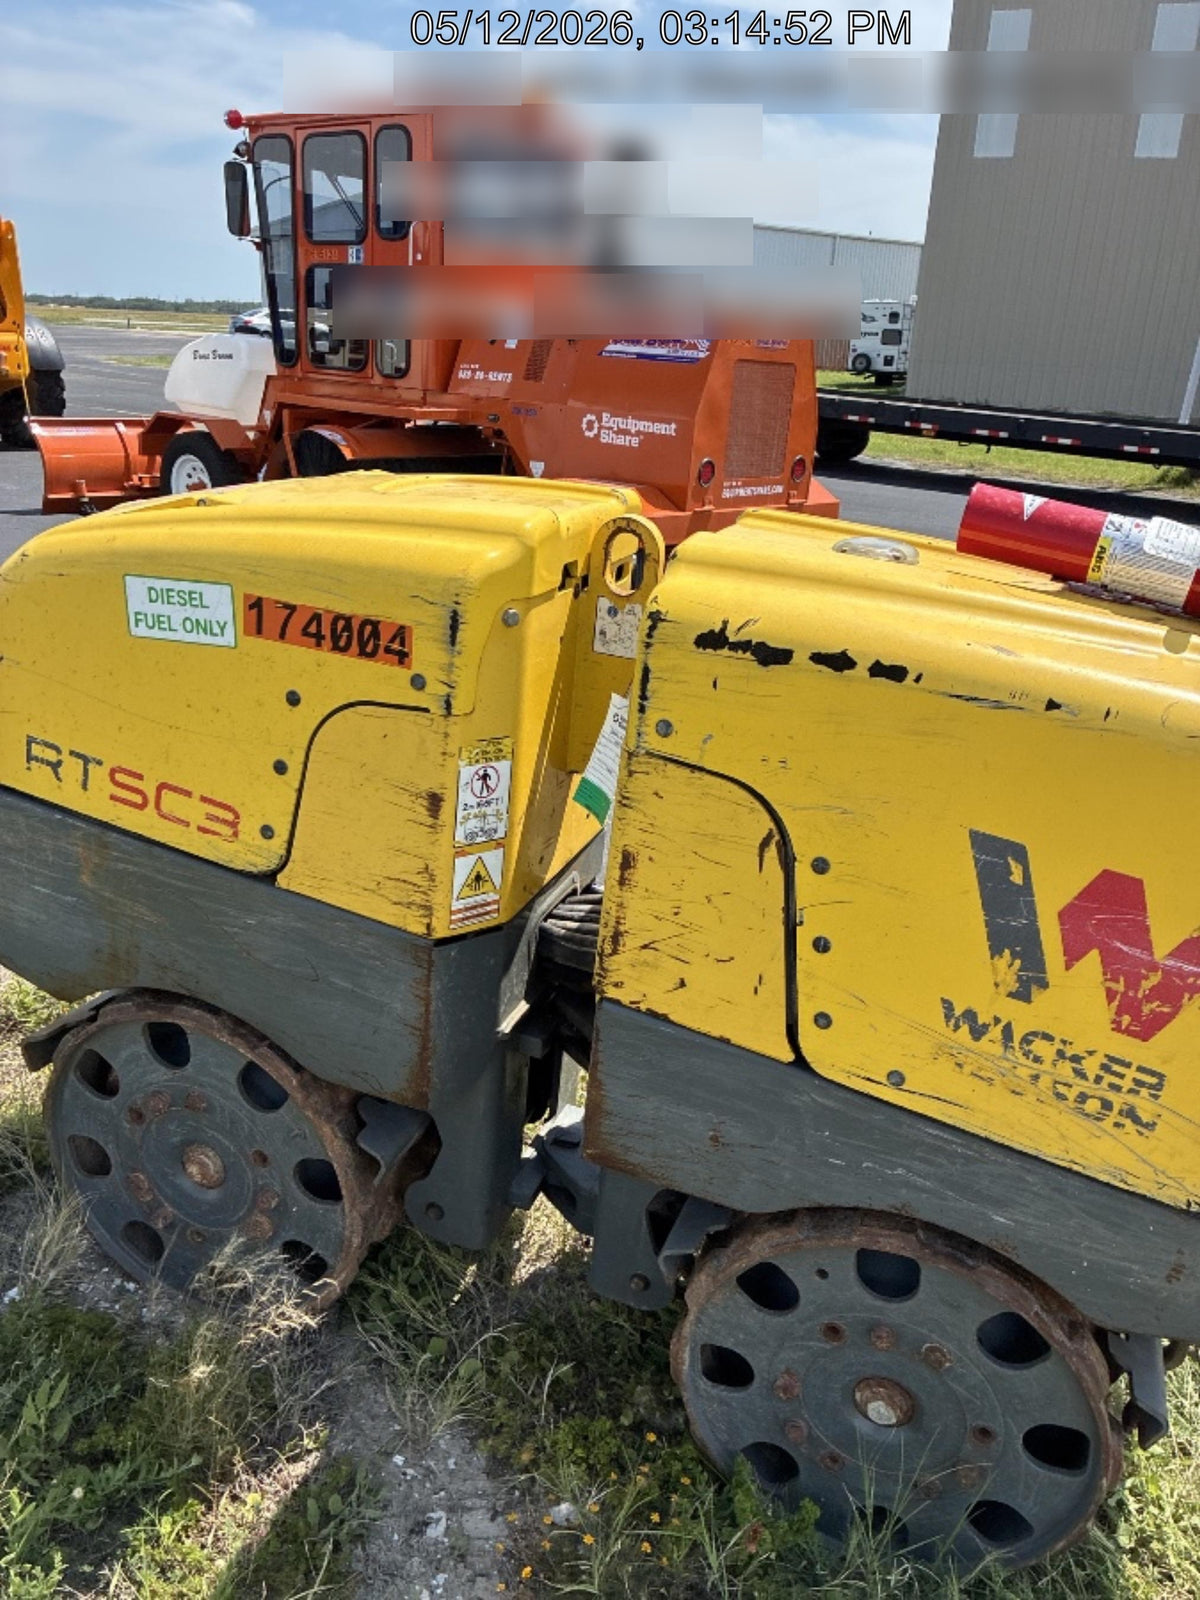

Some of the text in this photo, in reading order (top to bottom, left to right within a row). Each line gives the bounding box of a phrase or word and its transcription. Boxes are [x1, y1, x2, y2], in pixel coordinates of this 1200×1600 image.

[601, 412, 677, 436] Equipment
[600, 429, 639, 447] Share
[147, 586, 210, 609] DIESEL
[134, 615, 228, 638] FUEL ONLY
[247, 596, 411, 665] 174004
